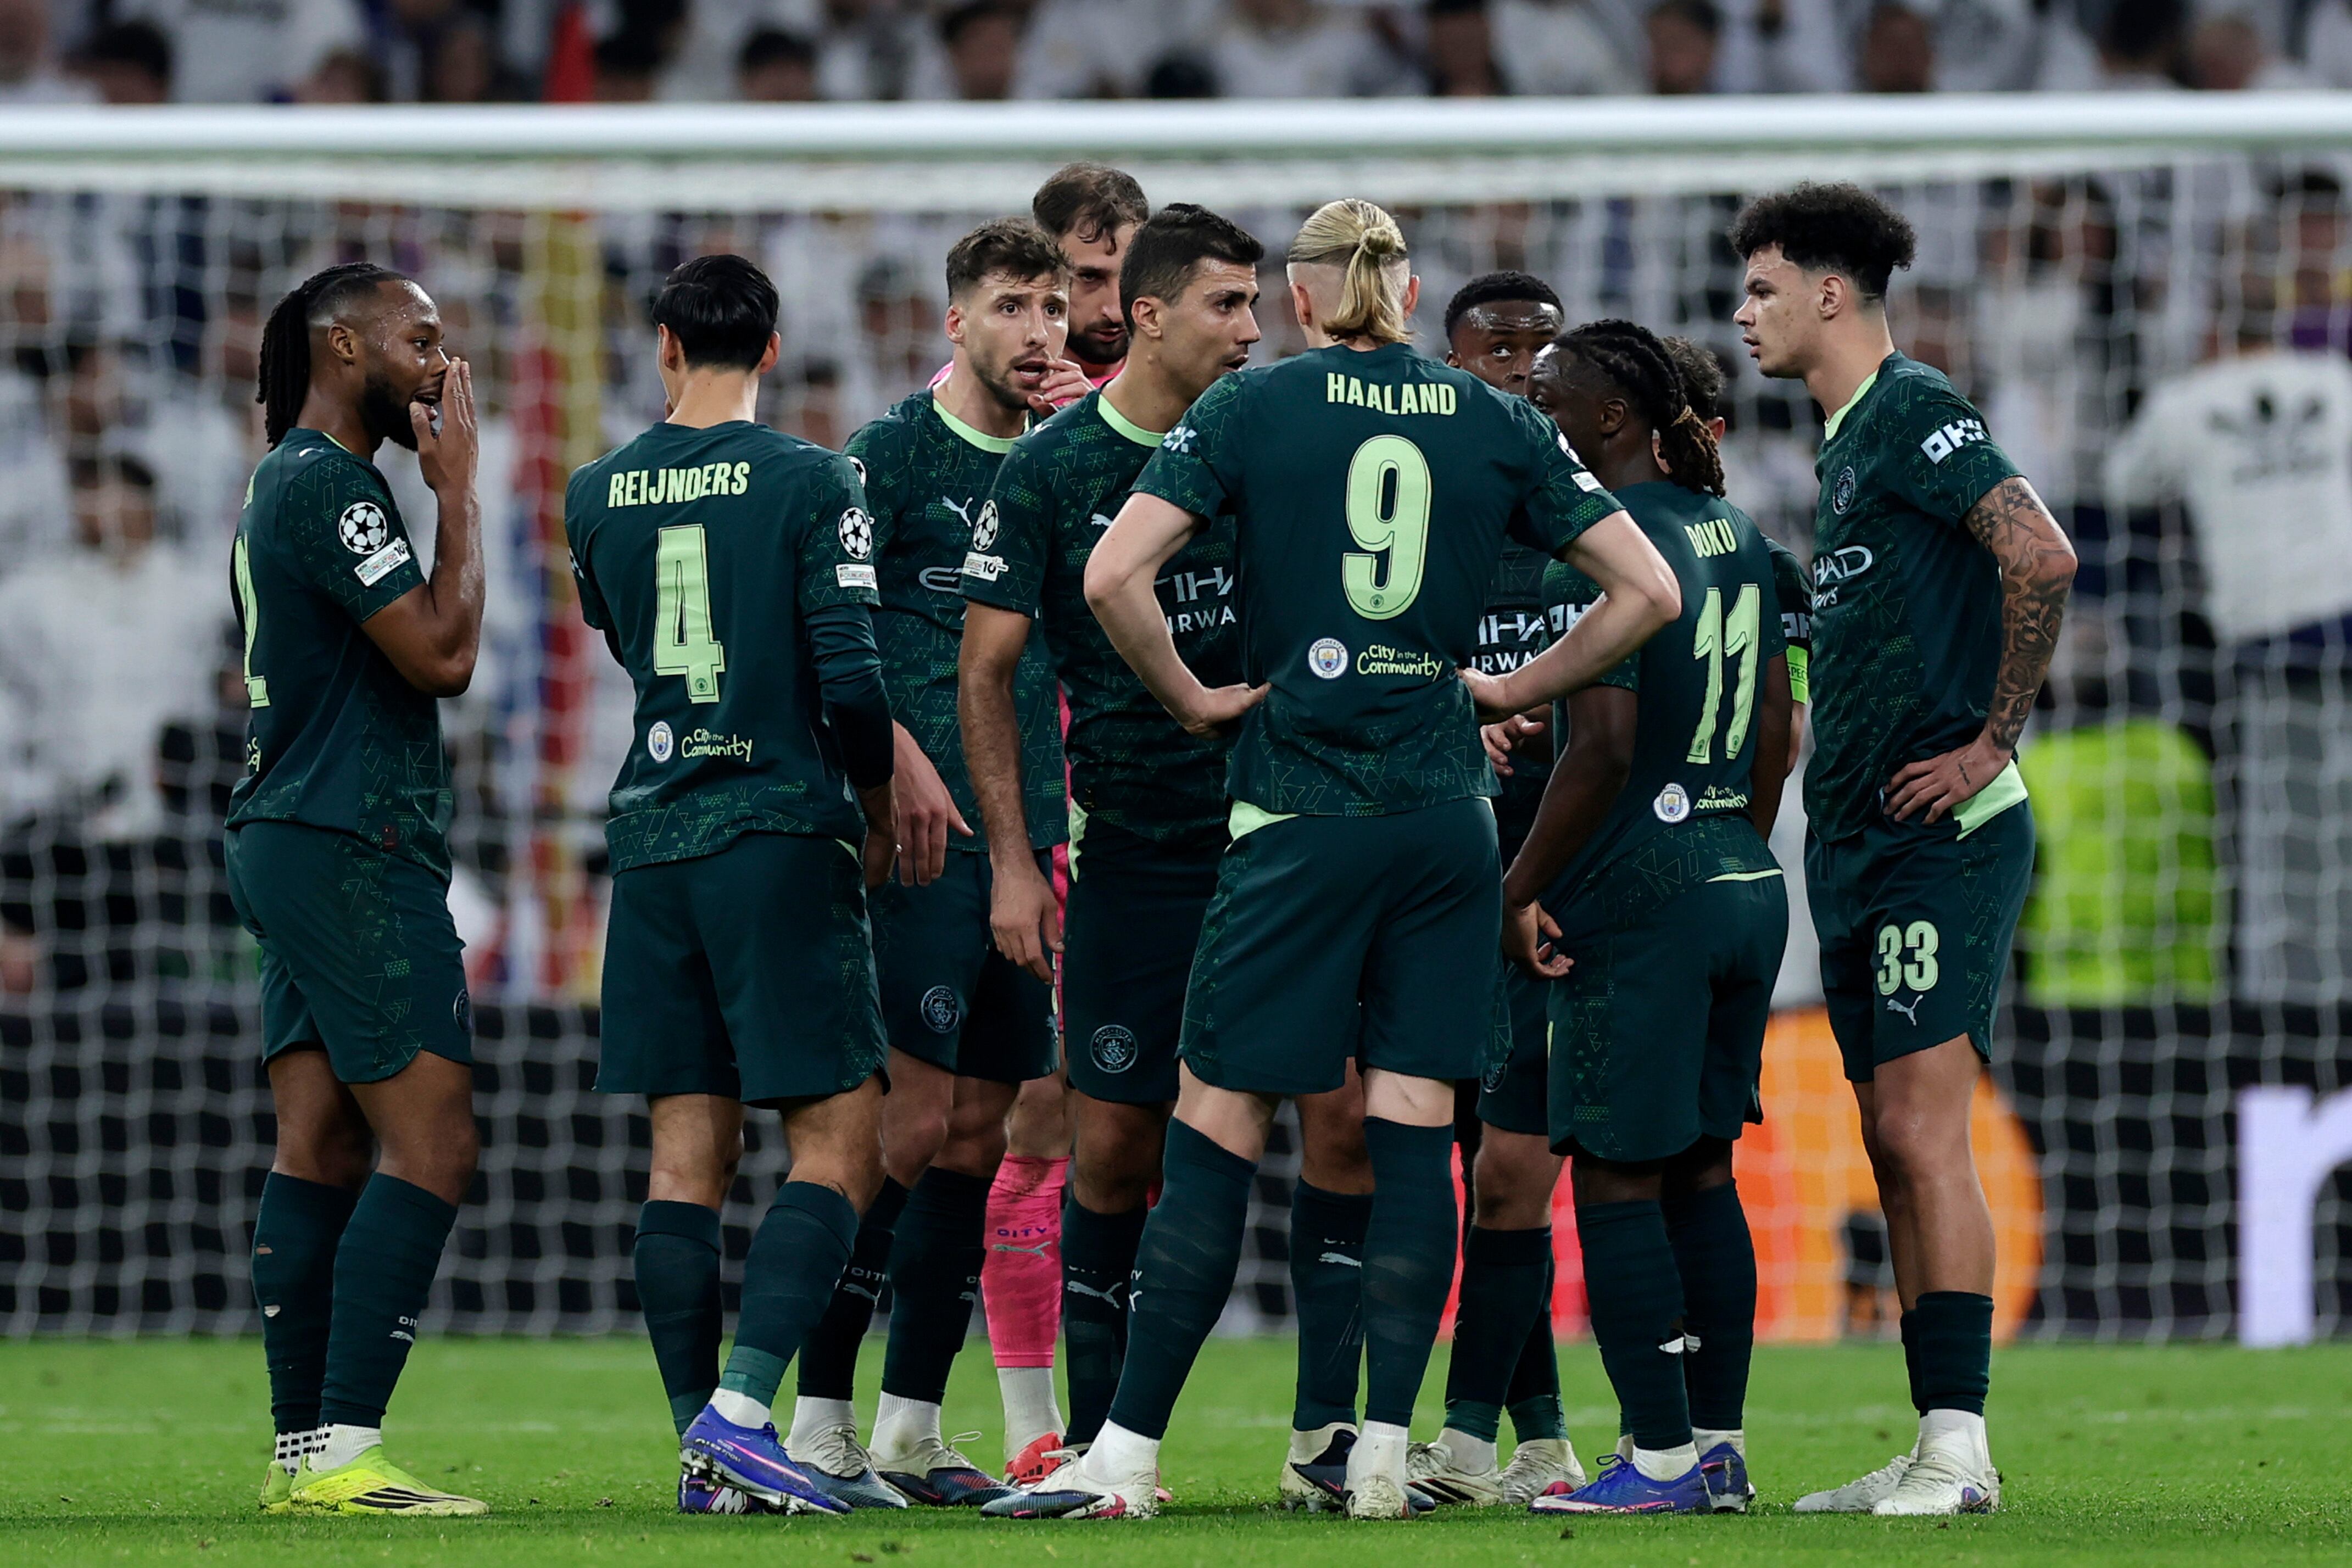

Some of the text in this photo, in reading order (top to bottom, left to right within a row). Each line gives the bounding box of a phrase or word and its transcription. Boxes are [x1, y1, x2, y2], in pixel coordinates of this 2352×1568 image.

[1327, 372, 1457, 416] HAALAND
[607, 461, 750, 507] REIJNDERS
[1342, 434, 1432, 620] 9
[1684, 518, 1737, 558] DOKU
[654, 523, 726, 704] 4
[1167, 605, 1236, 634] IRWA
[1357, 652, 1443, 682] Community
[1369, 645, 1396, 661] City
[1686, 583, 1760, 765] 11
[1877, 920, 1939, 996] 33
